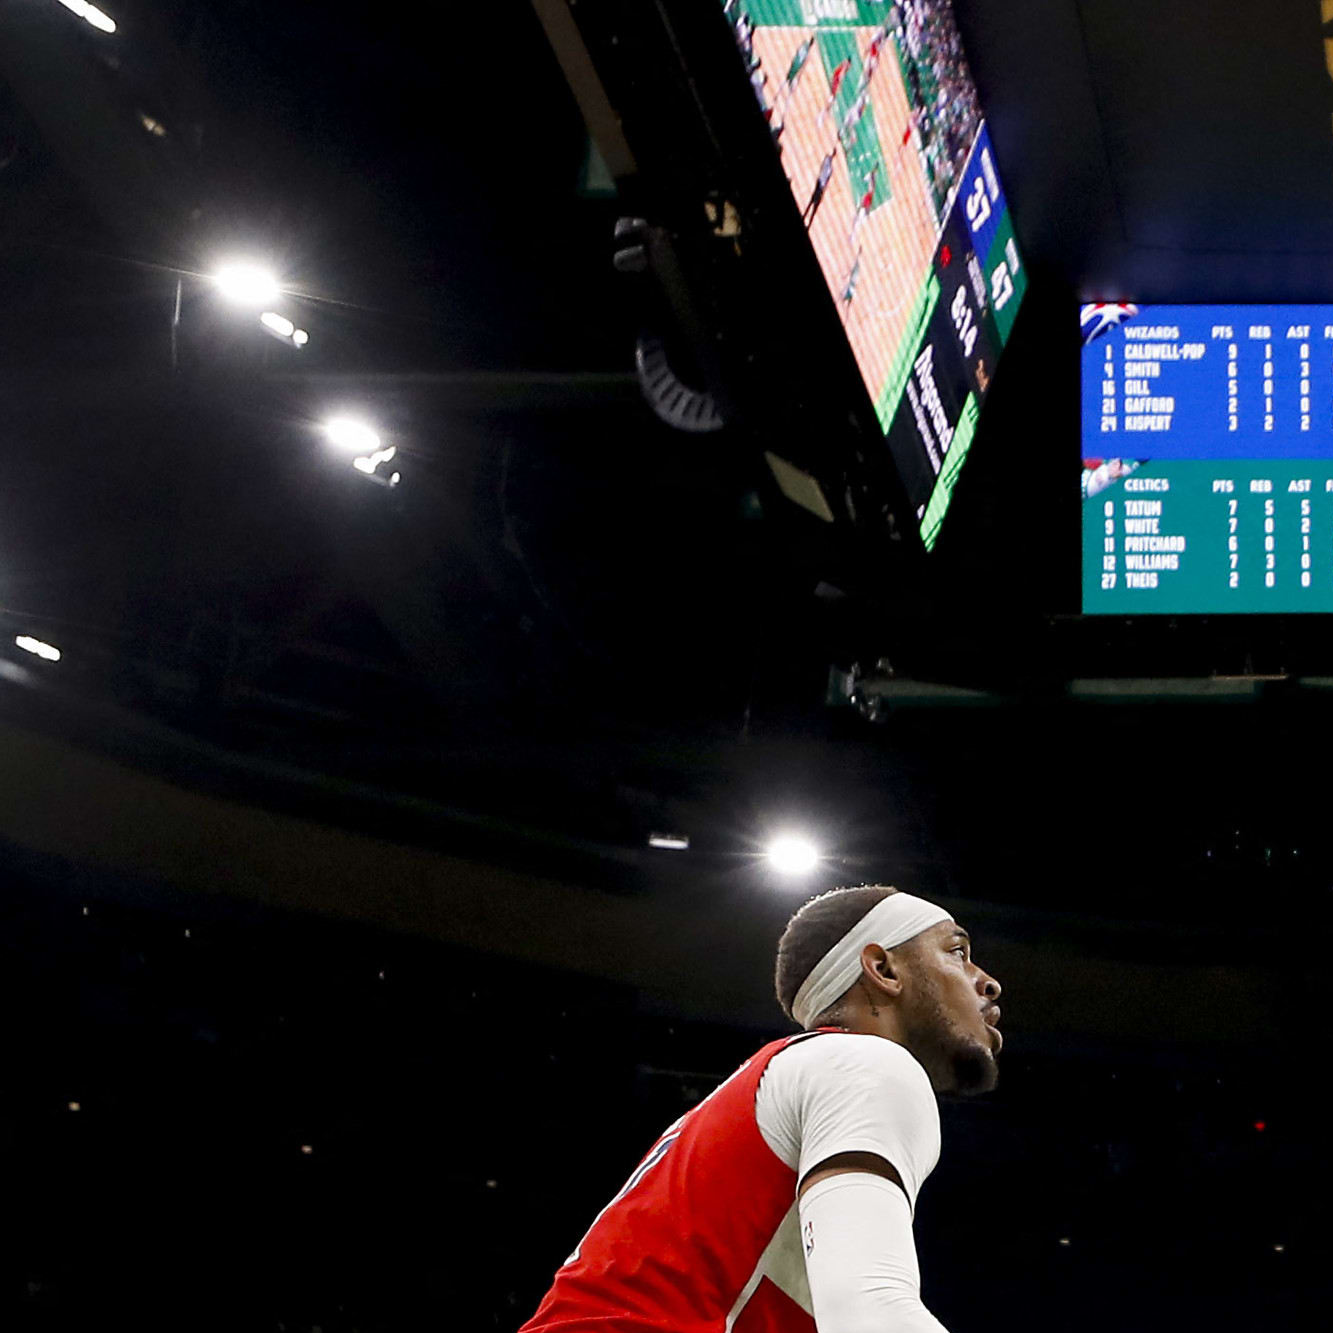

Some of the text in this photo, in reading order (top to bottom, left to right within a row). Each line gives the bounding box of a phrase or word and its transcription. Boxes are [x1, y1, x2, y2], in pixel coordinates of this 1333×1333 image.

[1212, 326, 1233, 339] PTS
[1249, 326, 1271, 339] REB
[1287, 326, 1310, 338] AST
[1213, 480, 1234, 492] PTS
[1250, 480, 1272, 492] REB
[1288, 480, 1311, 492] AST
